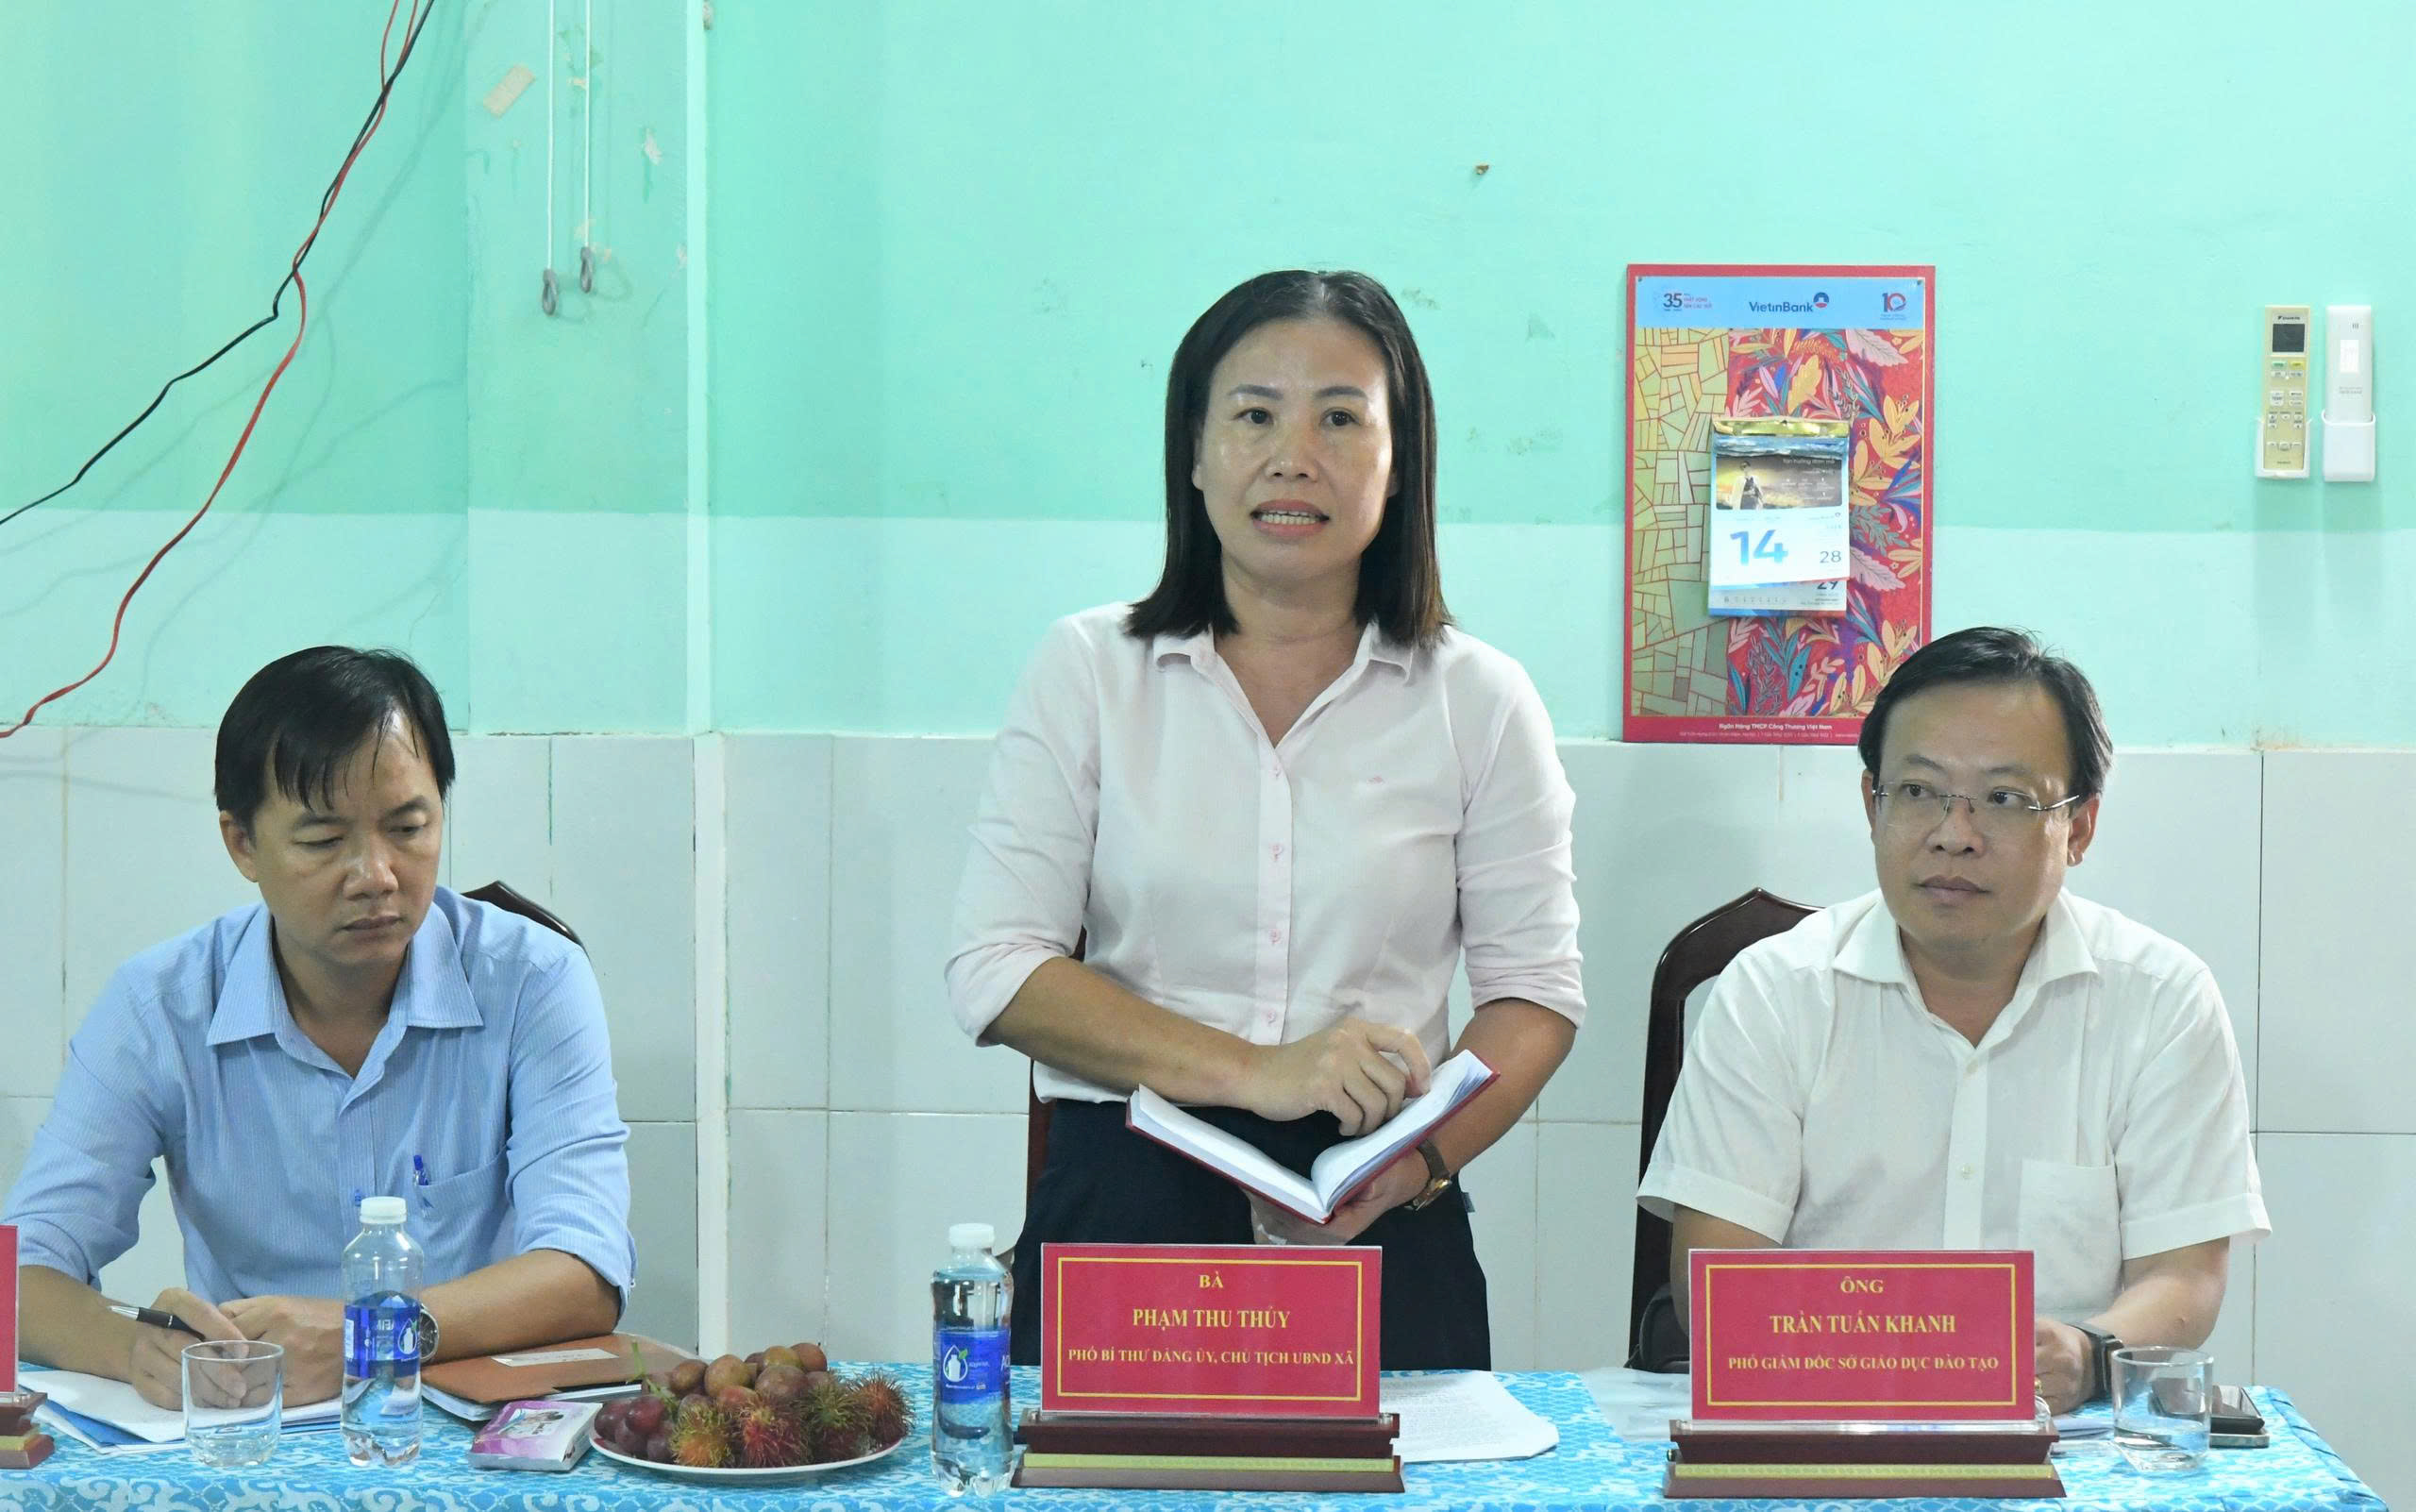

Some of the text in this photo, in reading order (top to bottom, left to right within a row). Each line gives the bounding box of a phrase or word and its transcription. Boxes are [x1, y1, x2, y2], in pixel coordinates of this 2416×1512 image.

[1662, 293, 1683, 308] 35
[1749, 301, 1814, 313] VietinBank
[1730, 529, 1788, 565] 14
[1819, 550, 1842, 563] 28
[1199, 1269, 1224, 1288] BÀ
[1840, 1275, 1885, 1294] ÔNG
[1132, 1308, 1188, 1331] PHẠM
[1193, 1309, 1233, 1328] THU
[1886, 1314, 1956, 1334] KHANH
[1068, 1345, 1098, 1361] PHÓ
[1101, 1346, 1116, 1362] BÍ
[1118, 1348, 1150, 1363] THƯ
[1152, 1347, 1193, 1364] ĐẢNG
[1254, 1351, 1288, 1367] TỊCH
[1293, 1351, 1332, 1365] UBND
[1334, 1350, 1354, 1365] XÃ
[1728, 1352, 1758, 1369] PHÓ
[1901, 1356, 1931, 1372] DỤC
[1968, 1356, 2000, 1372] TẠO
